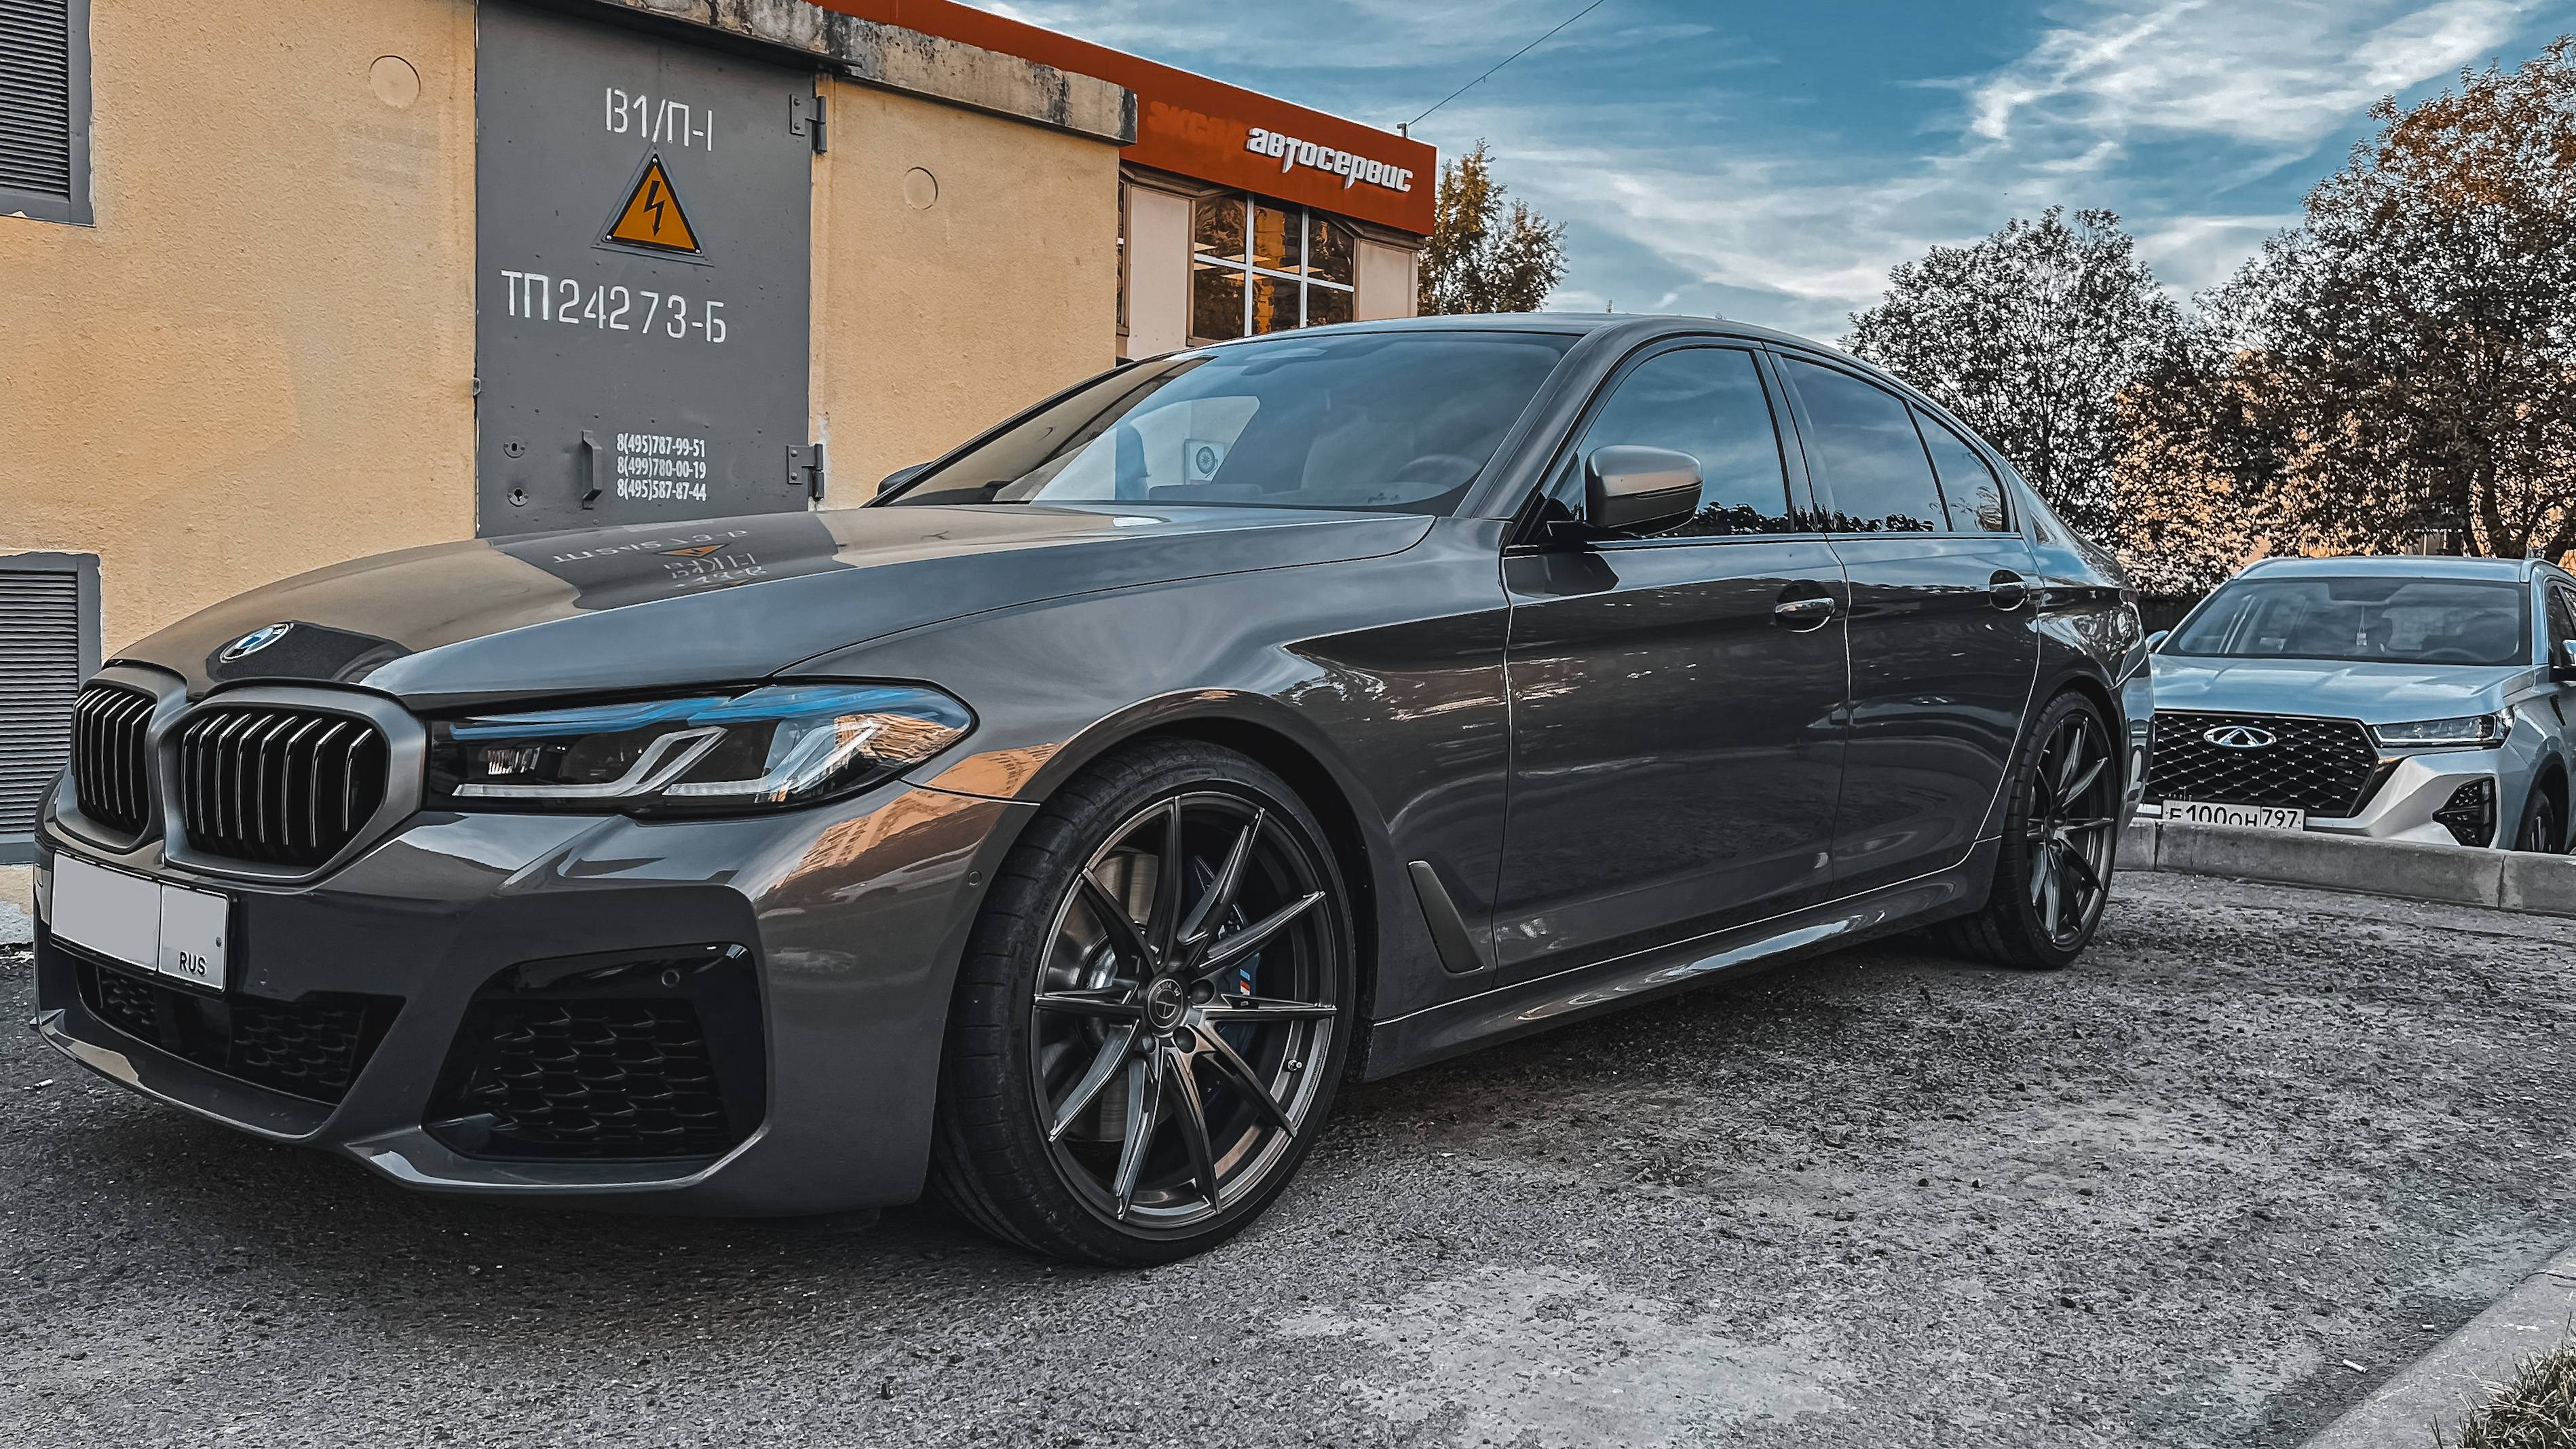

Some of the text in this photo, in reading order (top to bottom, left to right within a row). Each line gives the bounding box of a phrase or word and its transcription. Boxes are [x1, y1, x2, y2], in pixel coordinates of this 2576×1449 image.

[1247, 127, 1414, 192] автосервис
[617, 433, 705, 457] 8(495)787-99-51
[617, 455, 706, 479] 8(499)780-00-19
[617, 478, 706, 502] 8(495)587-87-44
[179, 951, 207, 975] RUS
